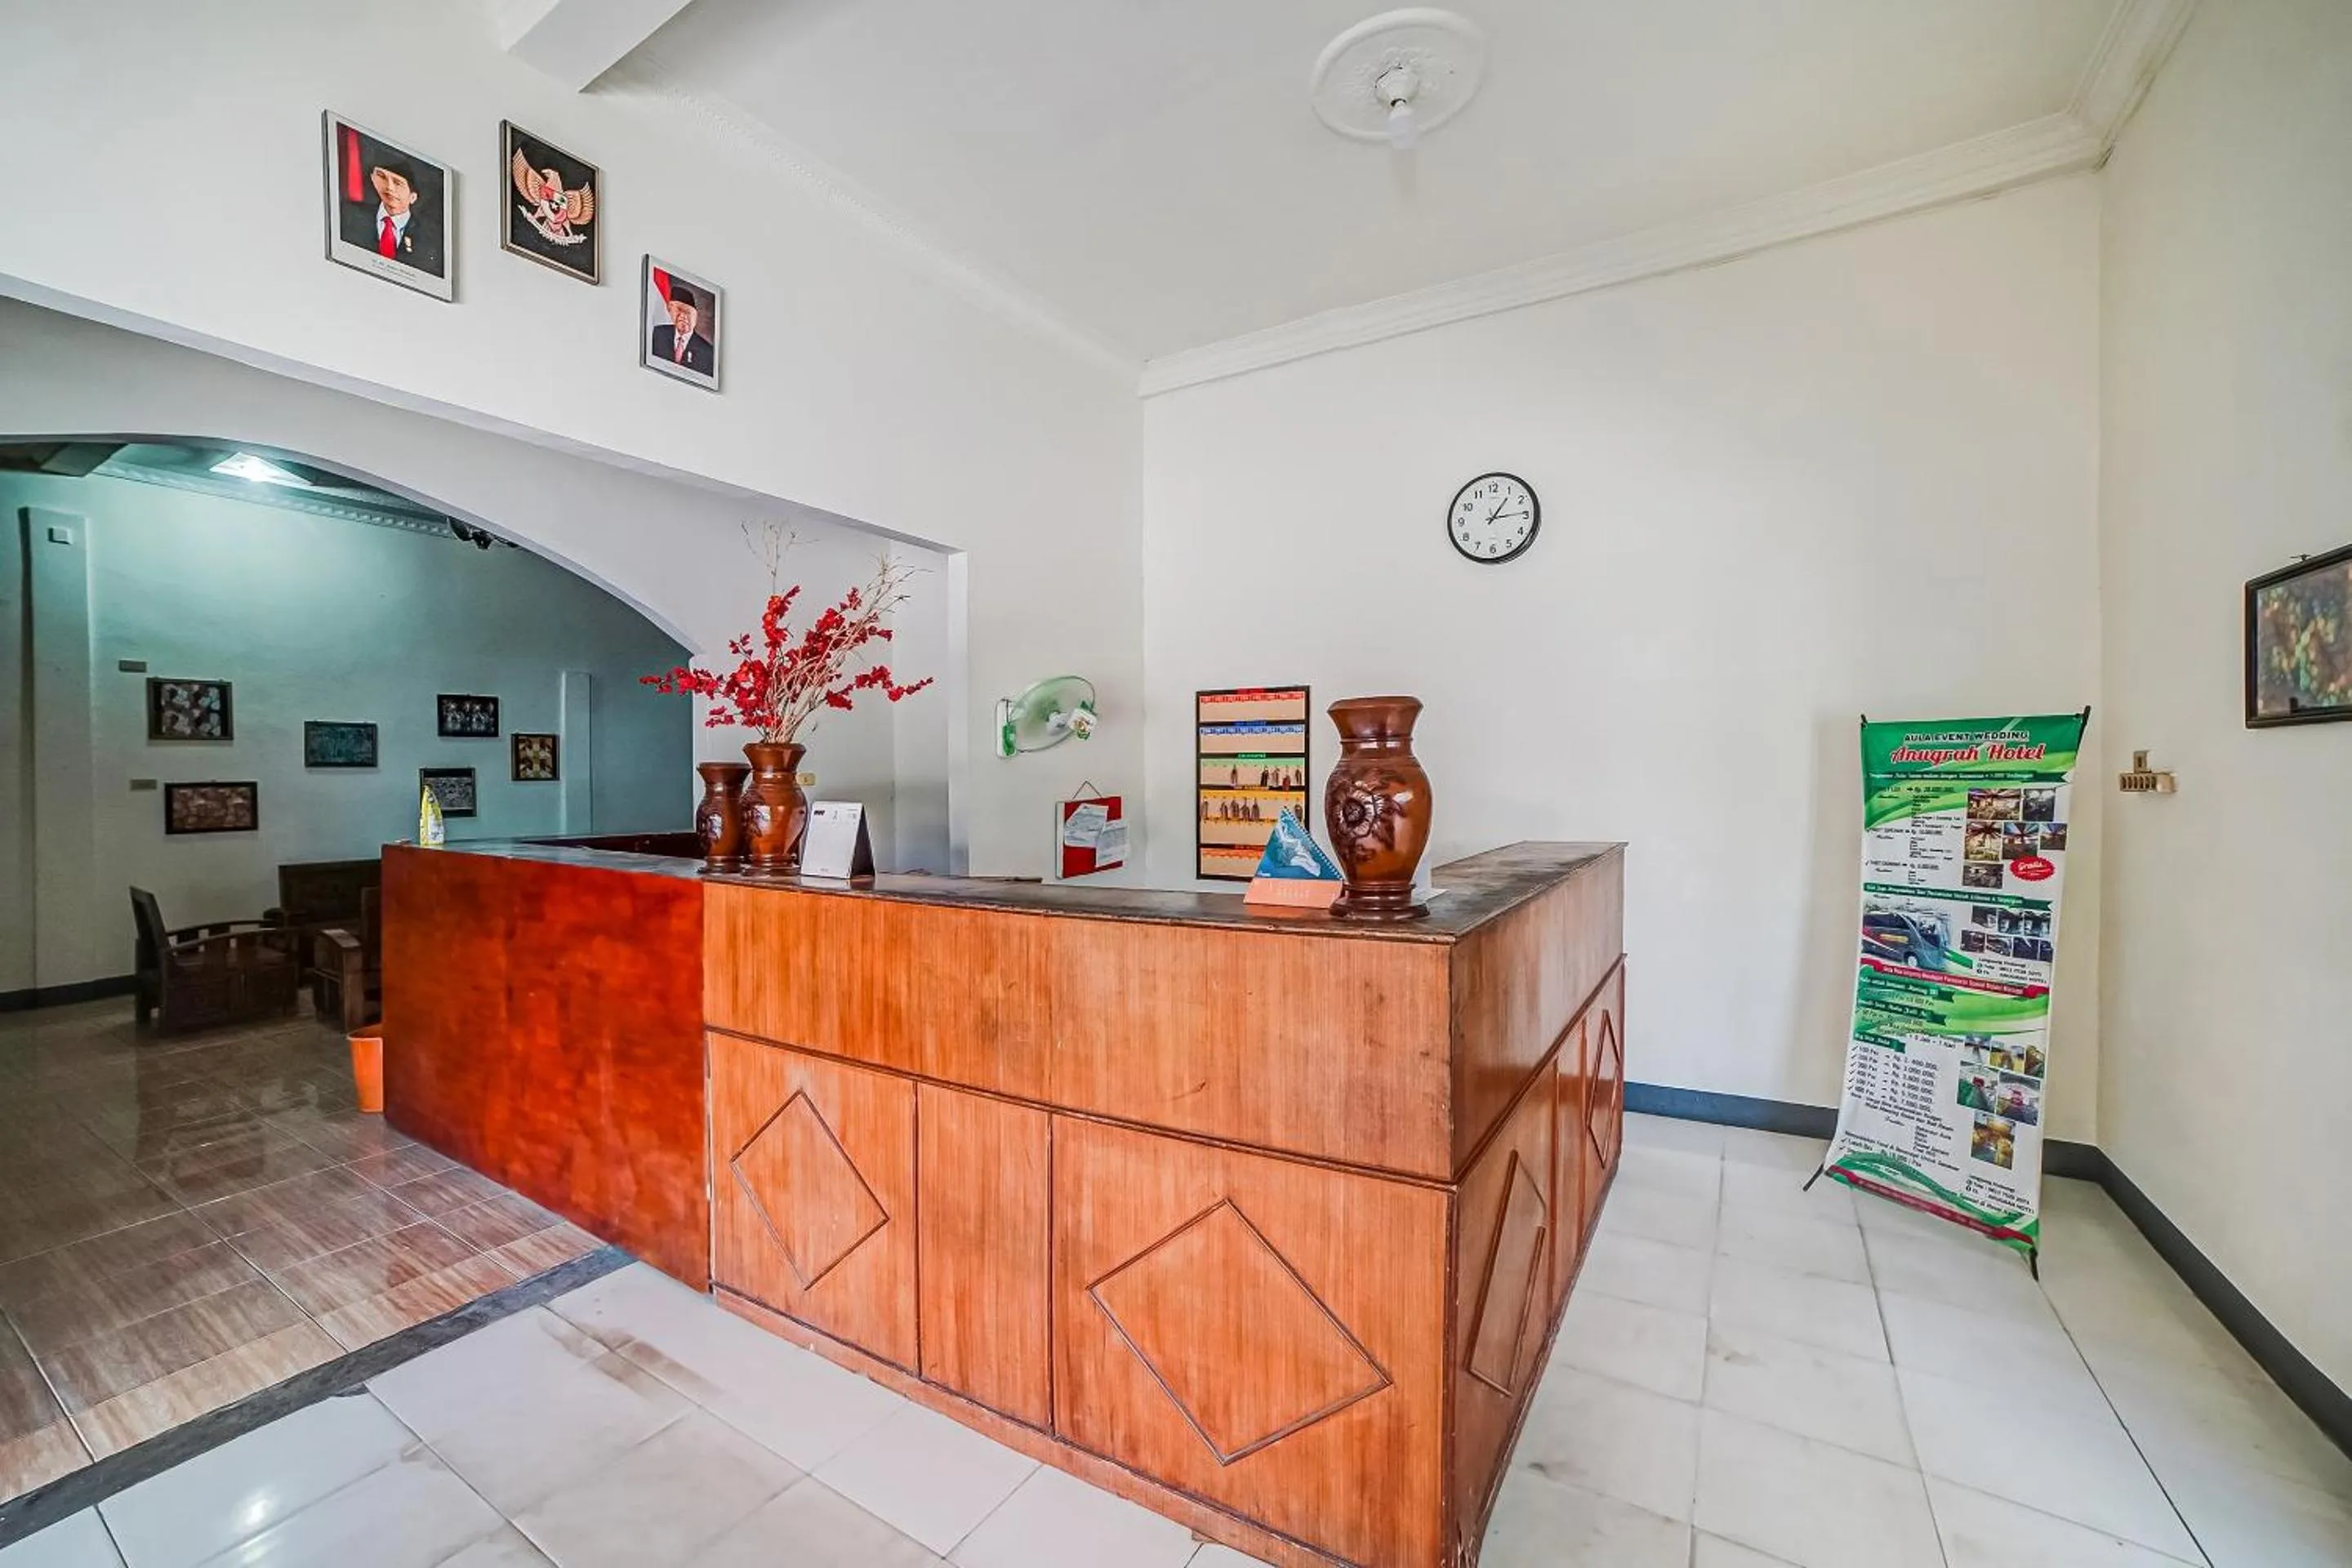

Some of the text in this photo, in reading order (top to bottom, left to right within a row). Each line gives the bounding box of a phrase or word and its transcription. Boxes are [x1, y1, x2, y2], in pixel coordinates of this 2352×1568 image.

[1488, 483, 1499, 493] 12
[1474, 490, 1482, 499] 11
[1517, 495, 1525, 505] 2
[1463, 502, 1473, 511] 10
[1522, 510, 1530, 520] 3
[1458, 517, 1465, 528] 9
[1517, 526, 1524, 536] 4
[1462, 532, 1470, 541] 8
[1475, 541, 1481, 550] 7
[1506, 539, 1512, 548] 5
[1489, 544, 1497, 555] 6
[1904, 733, 1931, 742] AULA
[1934, 733, 1970, 742] EVENT
[1891, 743, 2047, 766] Anugrah Hotel
